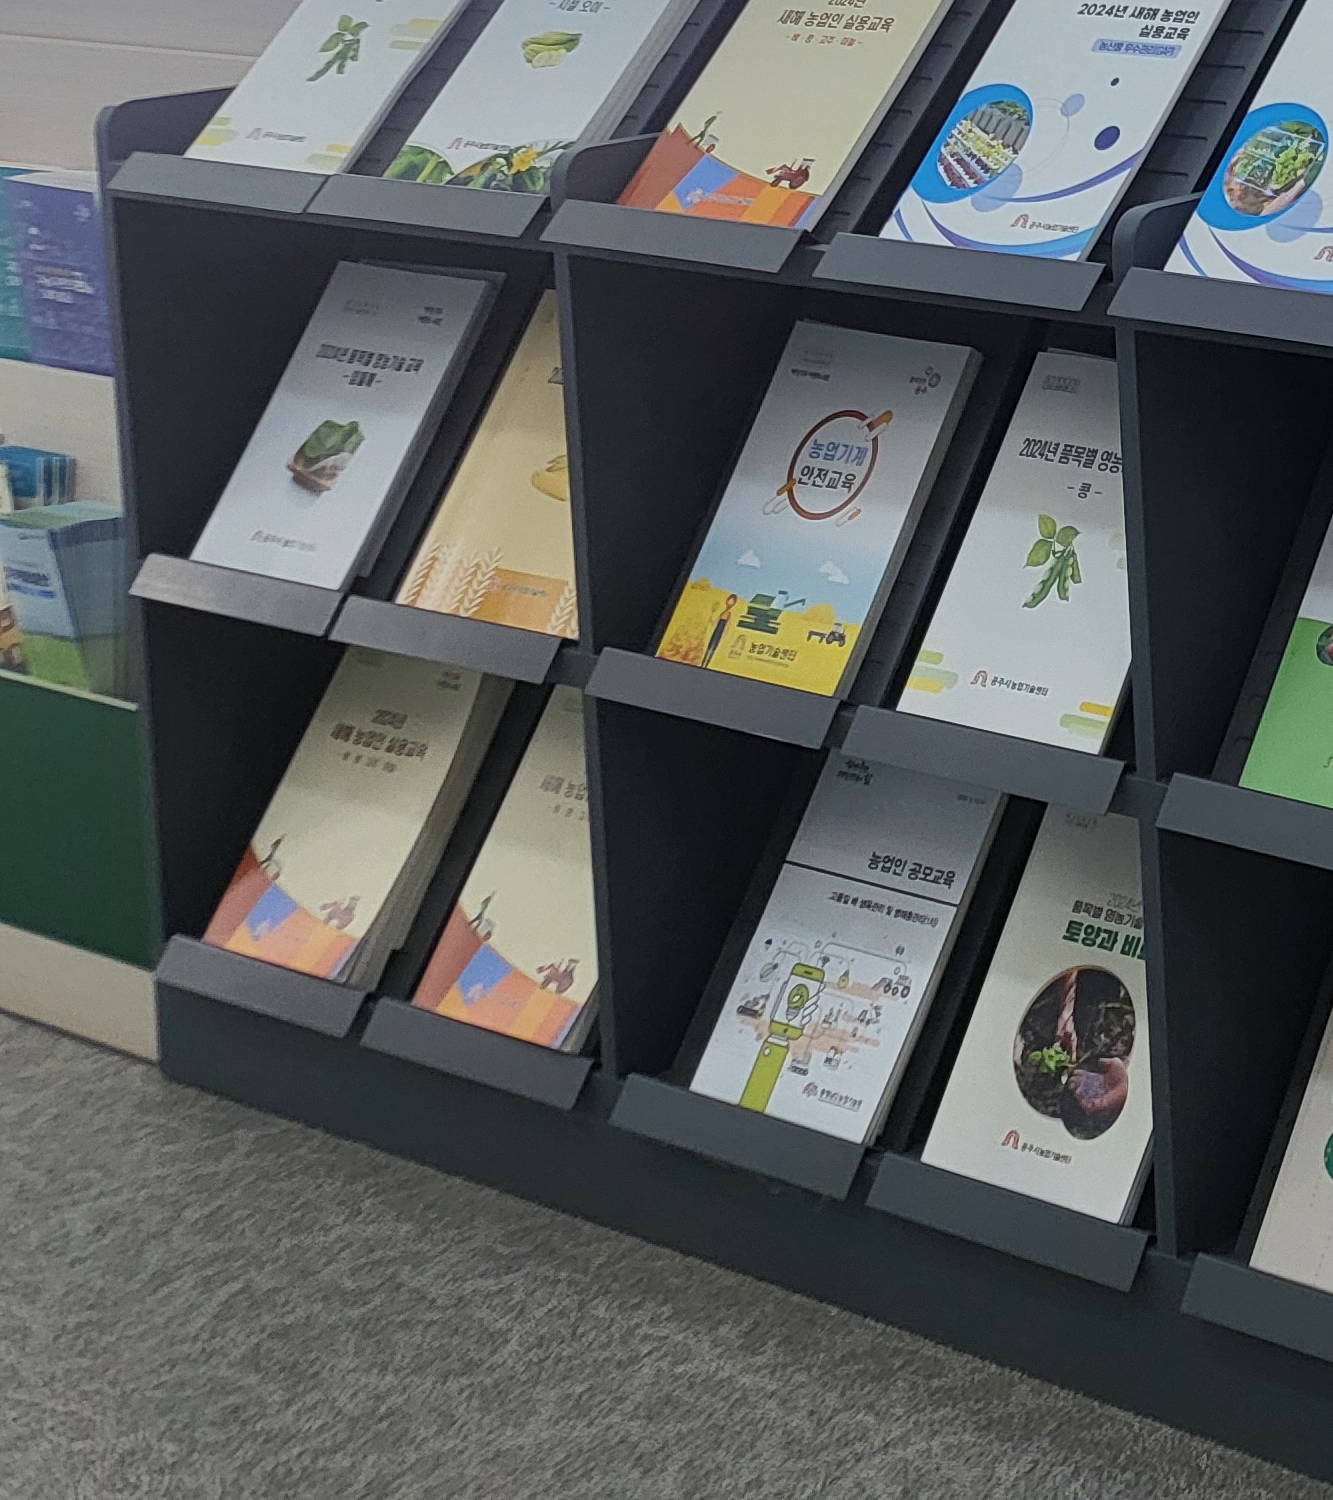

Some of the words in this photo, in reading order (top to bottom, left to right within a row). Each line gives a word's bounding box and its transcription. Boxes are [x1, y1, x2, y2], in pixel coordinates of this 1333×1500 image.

[777, 9, 806, 26] 새해
[804, 11, 844, 29] 농업인
[843, 14, 895, 34] 실용교육
[1077, 3, 1129, 18] 2024년
[1129, 7, 1160, 21] 새해
[1159, 9, 1200, 25] 농업인
[1138, 25, 1190, 41] 실용교육
[808, 439, 868, 466] 농업기계
[1019, 437, 1060, 462] 2024년
[1058, 443, 1099, 470] 품목별
[798, 465, 856, 494] 안전교육
[868, 851, 908, 877] 농업인
[907, 862, 956, 889] 공모교육
[1072, 900, 1103, 919] 품목별
[1062, 920, 1119, 952] 토양과
[1120, 934, 1146, 960] 비
